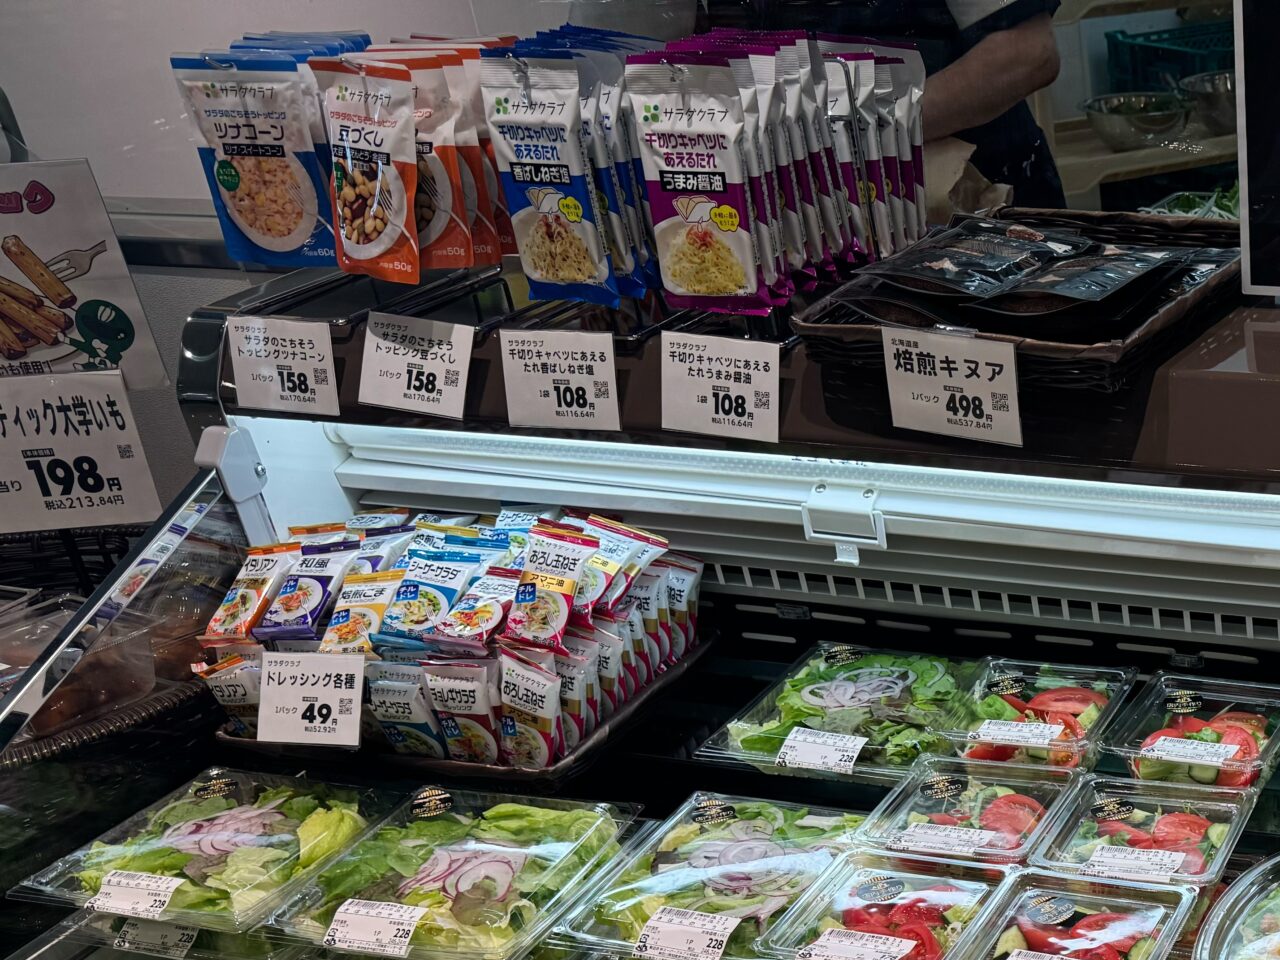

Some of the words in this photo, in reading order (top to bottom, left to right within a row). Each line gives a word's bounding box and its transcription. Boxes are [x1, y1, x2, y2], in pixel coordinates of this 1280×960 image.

[220, 87, 274, 99] サラダクラブ
[349, 91, 391, 105] サラダクラブ
[204, 109, 286, 120] サラダのごちそうトッピング
[511, 101, 566, 116] サラダクラブ
[663, 108, 729, 123] サラダクラブ
[214, 122, 285, 140] ツナコーン
[339, 125, 384, 147] 豆づくし
[498, 125, 567, 142] 千切りキャベツに
[645, 133, 728, 150] 千切りキャベツに
[514, 144, 560, 161] あえるたれ
[664, 152, 718, 169] あえるたれ
[513, 164, 570, 184] 香ばしねぎ塩
[663, 173, 725, 191] うまみ醤油
[234, 325, 267, 334] サラダクラブ
[374, 321, 408, 332] サラダクラブ
[244, 335, 315, 349] サラダのごちそう
[381, 331, 454, 351] サラダのごちそう
[508, 339, 544, 347] サラダクラブ
[669, 341, 707, 351] サラダクラブ
[891, 338, 919, 349] 北海道産
[237, 348, 326, 363] トッピングツナコーン
[375, 342, 456, 364] トッピング豆づくし
[508, 348, 607, 363] 千切りキャベツにあえる
[523, 362, 595, 376] たれ香ばしねぎ塩
[669, 351, 771, 372] 千切りキャベツにあえる
[894, 348, 1004, 382] 焙煎キヌア
[687, 366, 752, 384] たれうまみ醤油
[911, 392, 940, 404] 1パック
[44, 495, 125, 510] 税込213.84円
[244, 558, 278, 572] イタリアン
[298, 558, 331, 569] 和風
[529, 550, 579, 571] おろし玉ねぎ
[409, 560, 461, 580] シーザーサラダ
[530, 573, 564, 587] アマニ油
[341, 587, 387, 600] 焙煎ごま
[266, 671, 356, 690] ドレッシング各種
[515, 672, 547, 689] サラダクラブ
[503, 680, 546, 709] おろし玉ねぎ
[275, 706, 298, 714] 1パック
[838, 754, 855, 763] 228
[149, 899, 167, 909] 228
[393, 928, 411, 939] 228
[706, 938, 724, 950] 228
